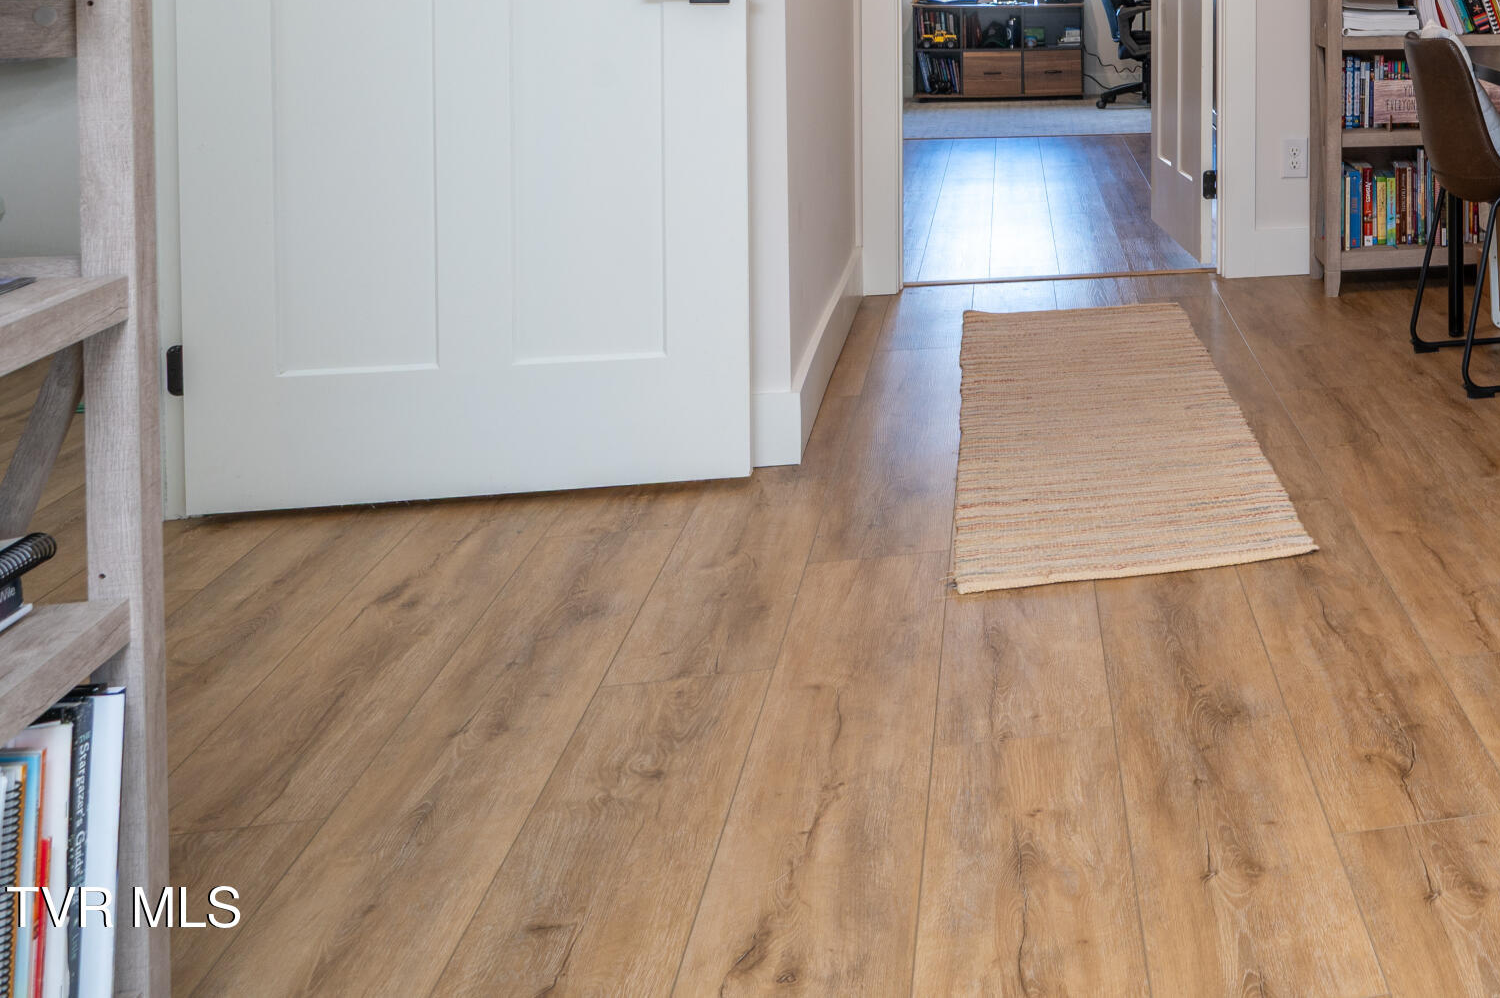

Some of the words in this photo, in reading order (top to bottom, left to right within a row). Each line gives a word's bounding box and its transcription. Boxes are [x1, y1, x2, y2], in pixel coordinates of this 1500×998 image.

[1386, 99, 1417, 112] EVERYON
[76, 742, 90, 827] Stargazer's
[74, 830, 87, 878] Guide
